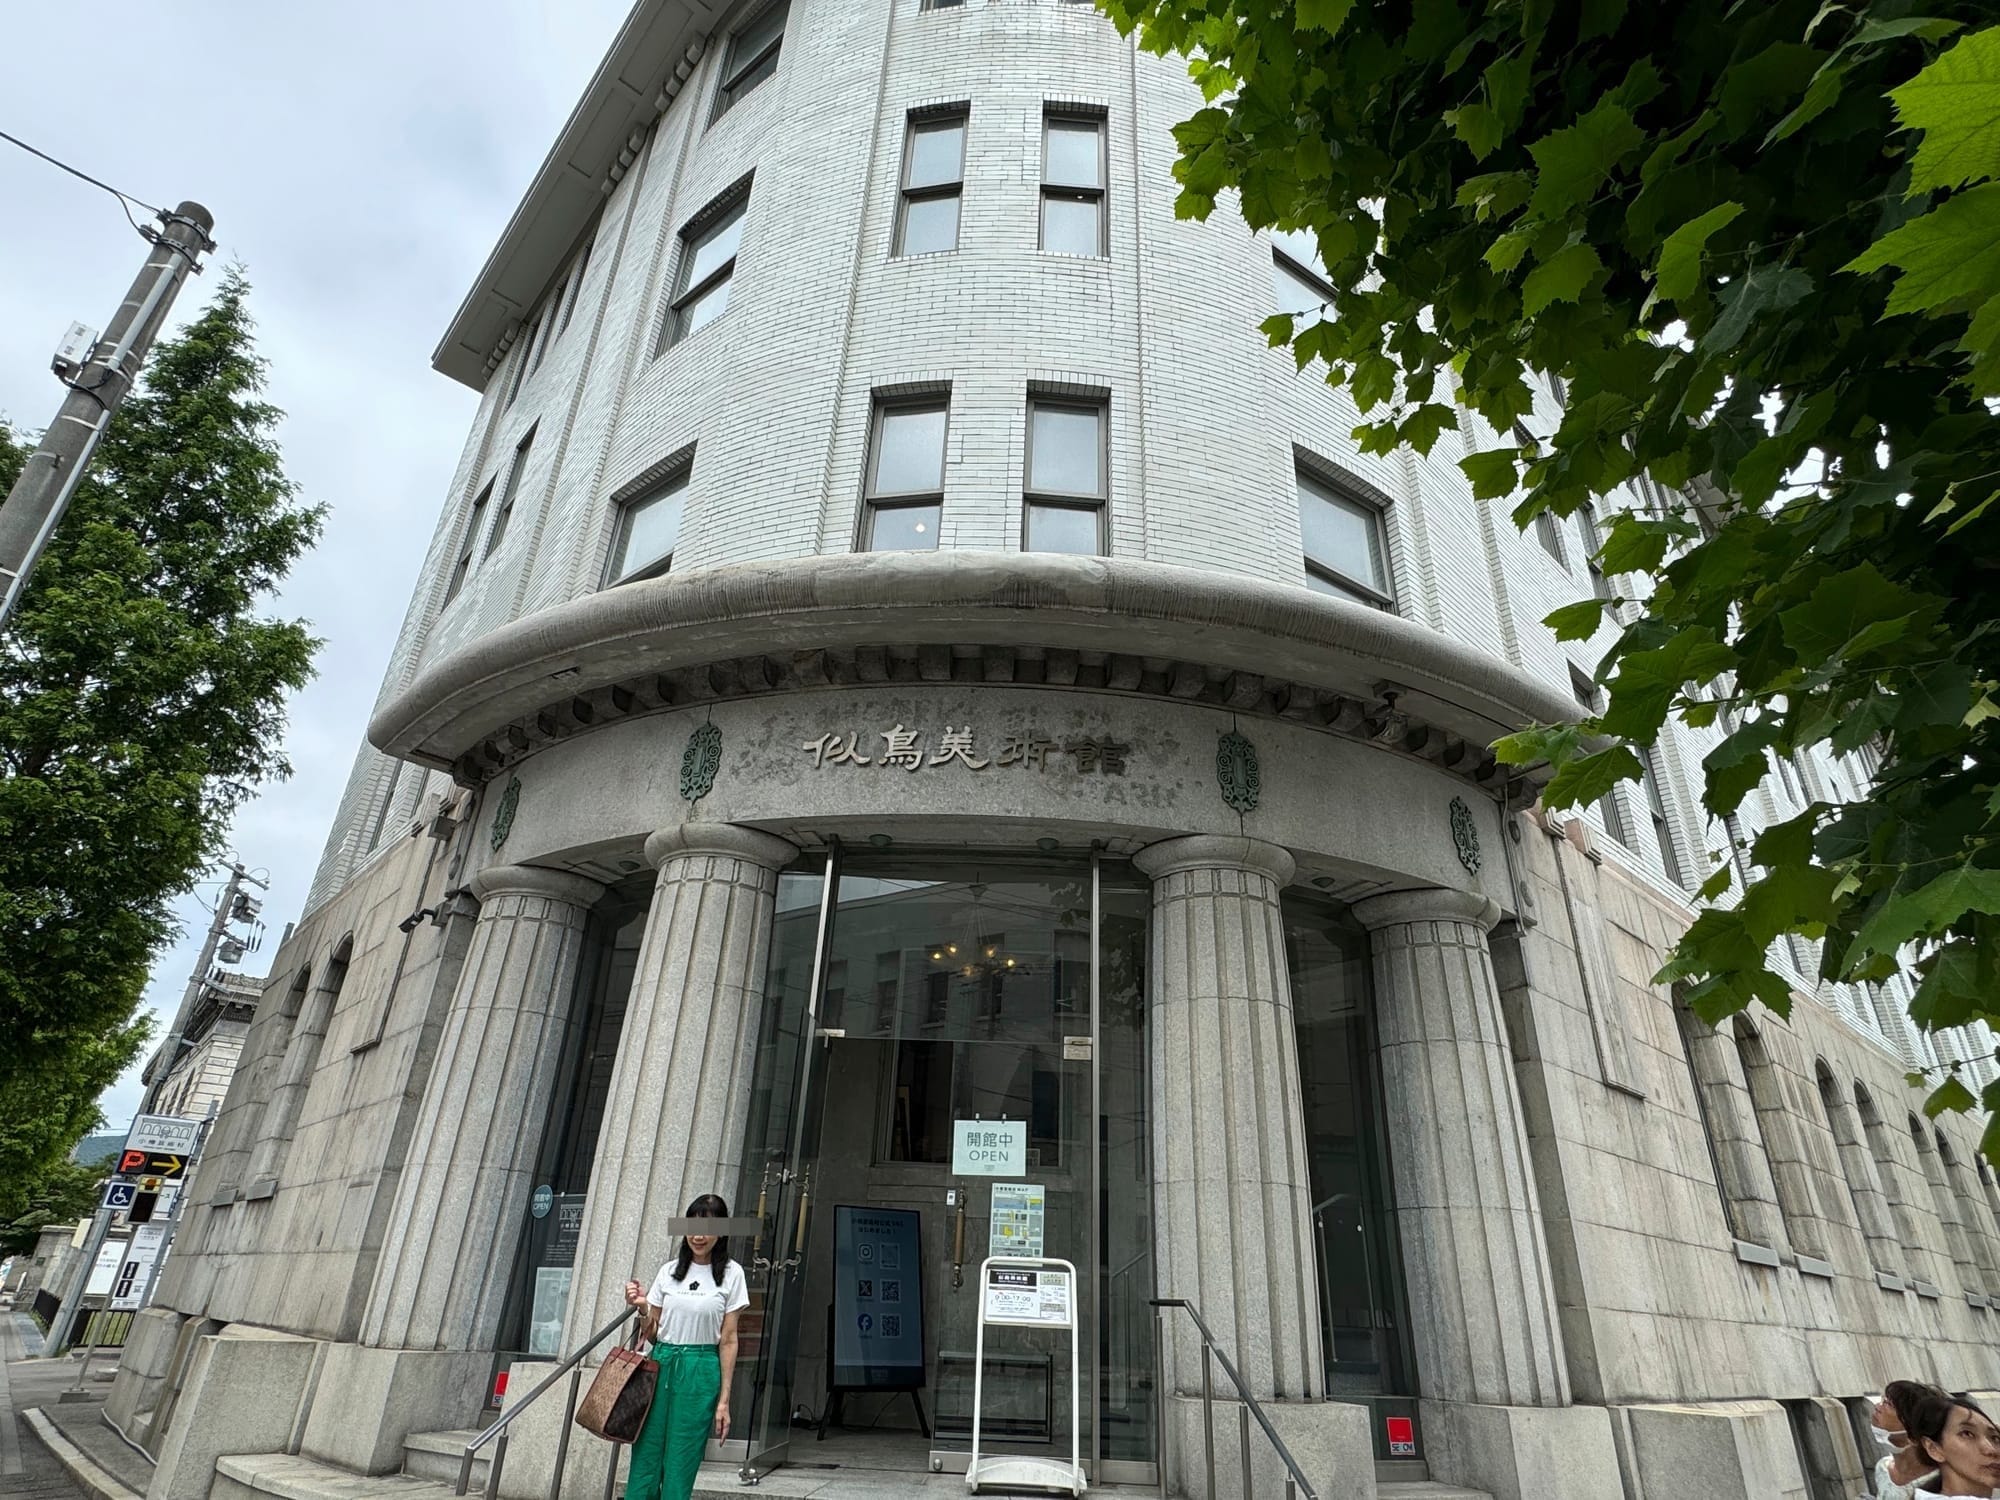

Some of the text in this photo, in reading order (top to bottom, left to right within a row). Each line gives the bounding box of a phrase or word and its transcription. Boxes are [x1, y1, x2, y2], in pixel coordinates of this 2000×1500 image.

[802, 723, 1130, 776] 似鳥美術館
[967, 1132, 1013, 1148] 開館中
[119, 1151, 145, 1172] P
[969, 1150, 1009, 1162] OPEN
